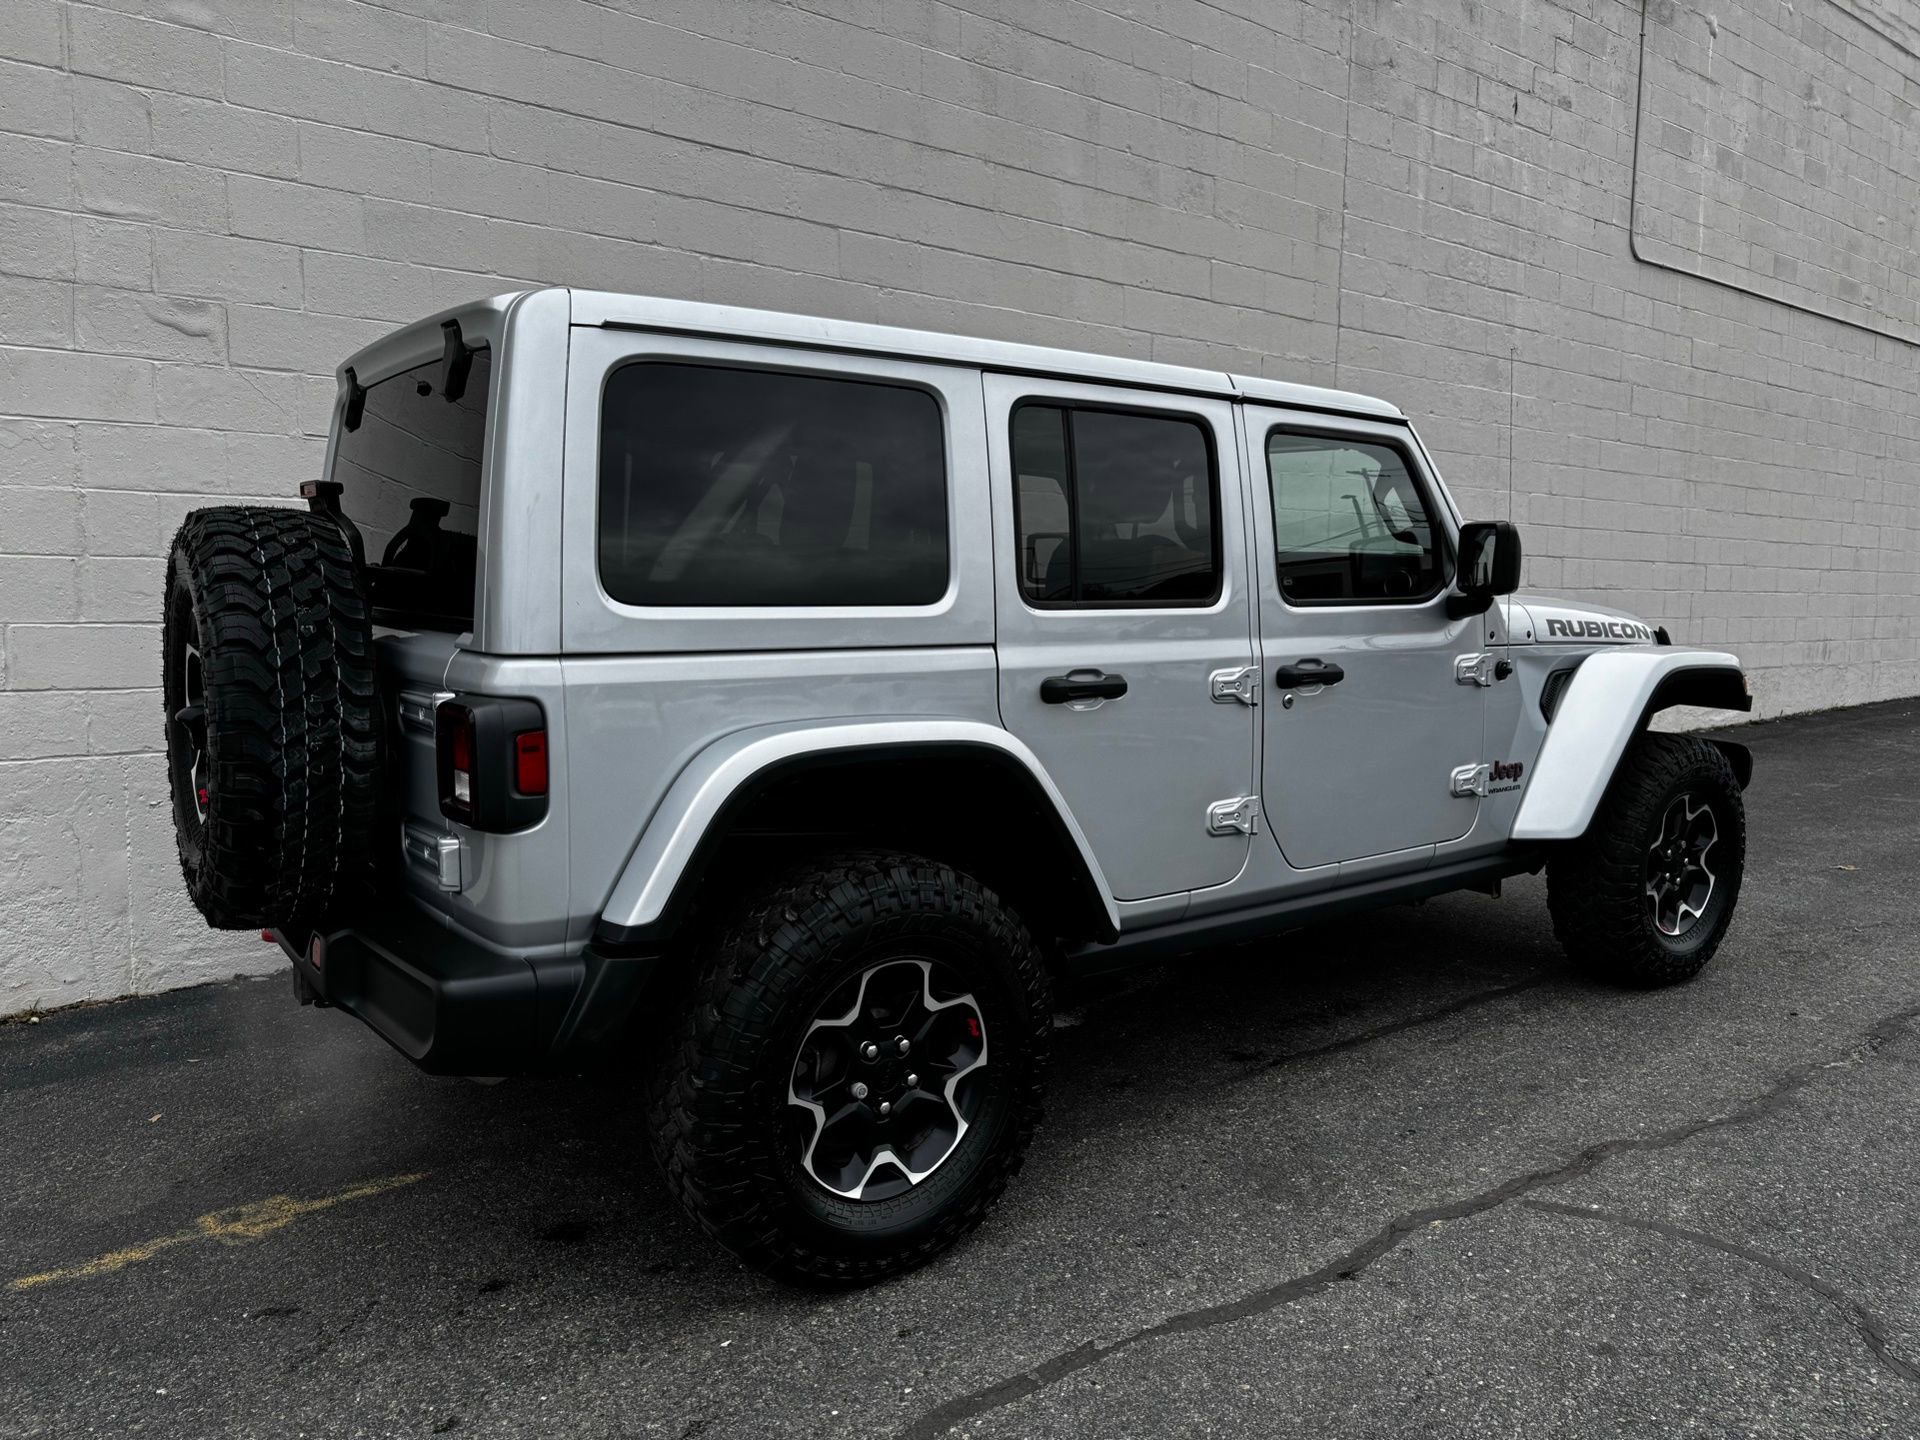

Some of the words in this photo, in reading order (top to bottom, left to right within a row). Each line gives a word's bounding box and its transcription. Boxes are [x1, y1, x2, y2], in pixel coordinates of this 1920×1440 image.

[1546, 619, 1651, 640] RUBICON
[1489, 760, 1523, 782] Jeep
[1488, 784, 1521, 795] WRANGLER
